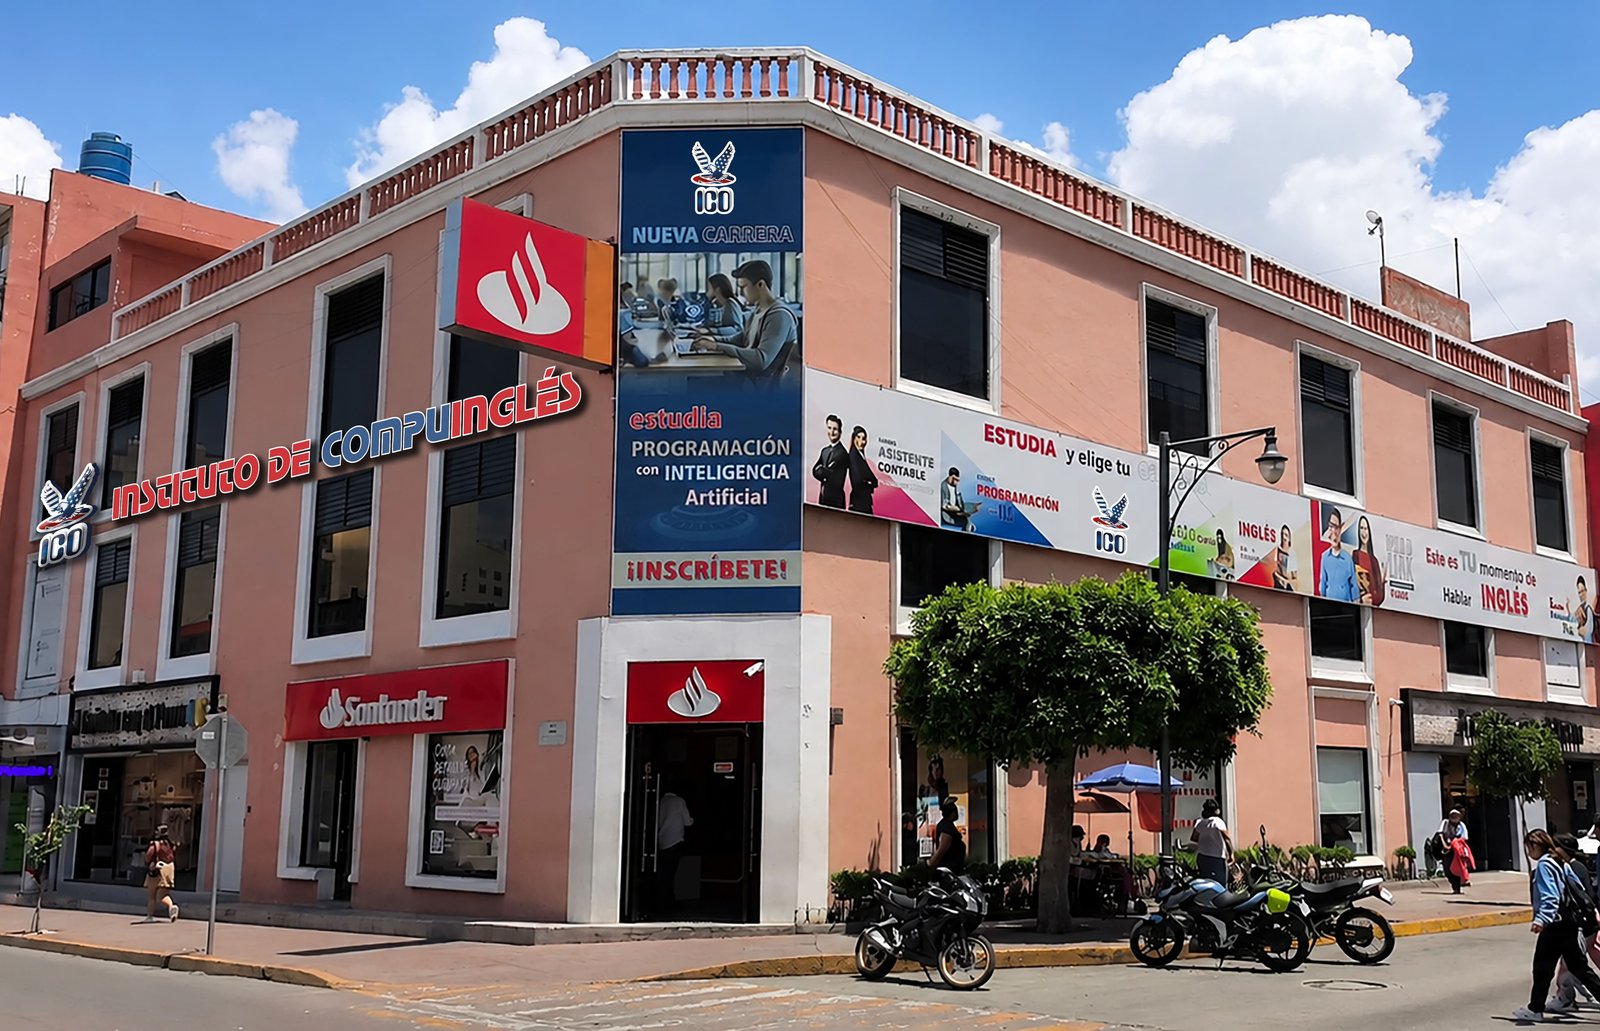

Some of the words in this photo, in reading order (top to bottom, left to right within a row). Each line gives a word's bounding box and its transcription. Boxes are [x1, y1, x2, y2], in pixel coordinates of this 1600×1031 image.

[694, 186, 734, 215] ICO
[632, 226, 699, 244] NUEVA
[702, 225, 794, 243] CARRERA
[628, 405, 722, 430] estudia
[111, 452, 261, 521] INSTITUTO
[266, 438, 312, 484] DE
[321, 365, 583, 469] COMPUINGLÉS
[631, 434, 791, 457] PROGRAMACIÓN
[983, 423, 1057, 457] ESTUDIA
[1065, 448, 1076, 466] y
[1078, 449, 1113, 474] elige
[1116, 459, 1131, 477] tu
[877, 461, 927, 481] CONTABLE
[878, 446, 935, 469] ASISTENTE
[635, 465, 660, 476] con
[664, 463, 790, 481] INTELIGENCIA
[685, 487, 768, 506] Artificial
[976, 483, 1060, 513] PROGRAMACIÓN
[37, 522, 89, 567] ICO
[1094, 530, 1127, 555] ICO
[1238, 520, 1277, 543] INGLÉS
[626, 552, 787, 581] ¡INSCRÍBETE!
[1425, 547, 1446, 568] Este
[1447, 557, 1459, 570] es
[1459, 550, 1477, 573] TU
[1479, 563, 1524, 583] momento
[1525, 571, 1537, 587] de
[1443, 587, 1472, 607] Hablar
[1481, 583, 1529, 617] INGLÉS
[344, 690, 448, 727] Santander
